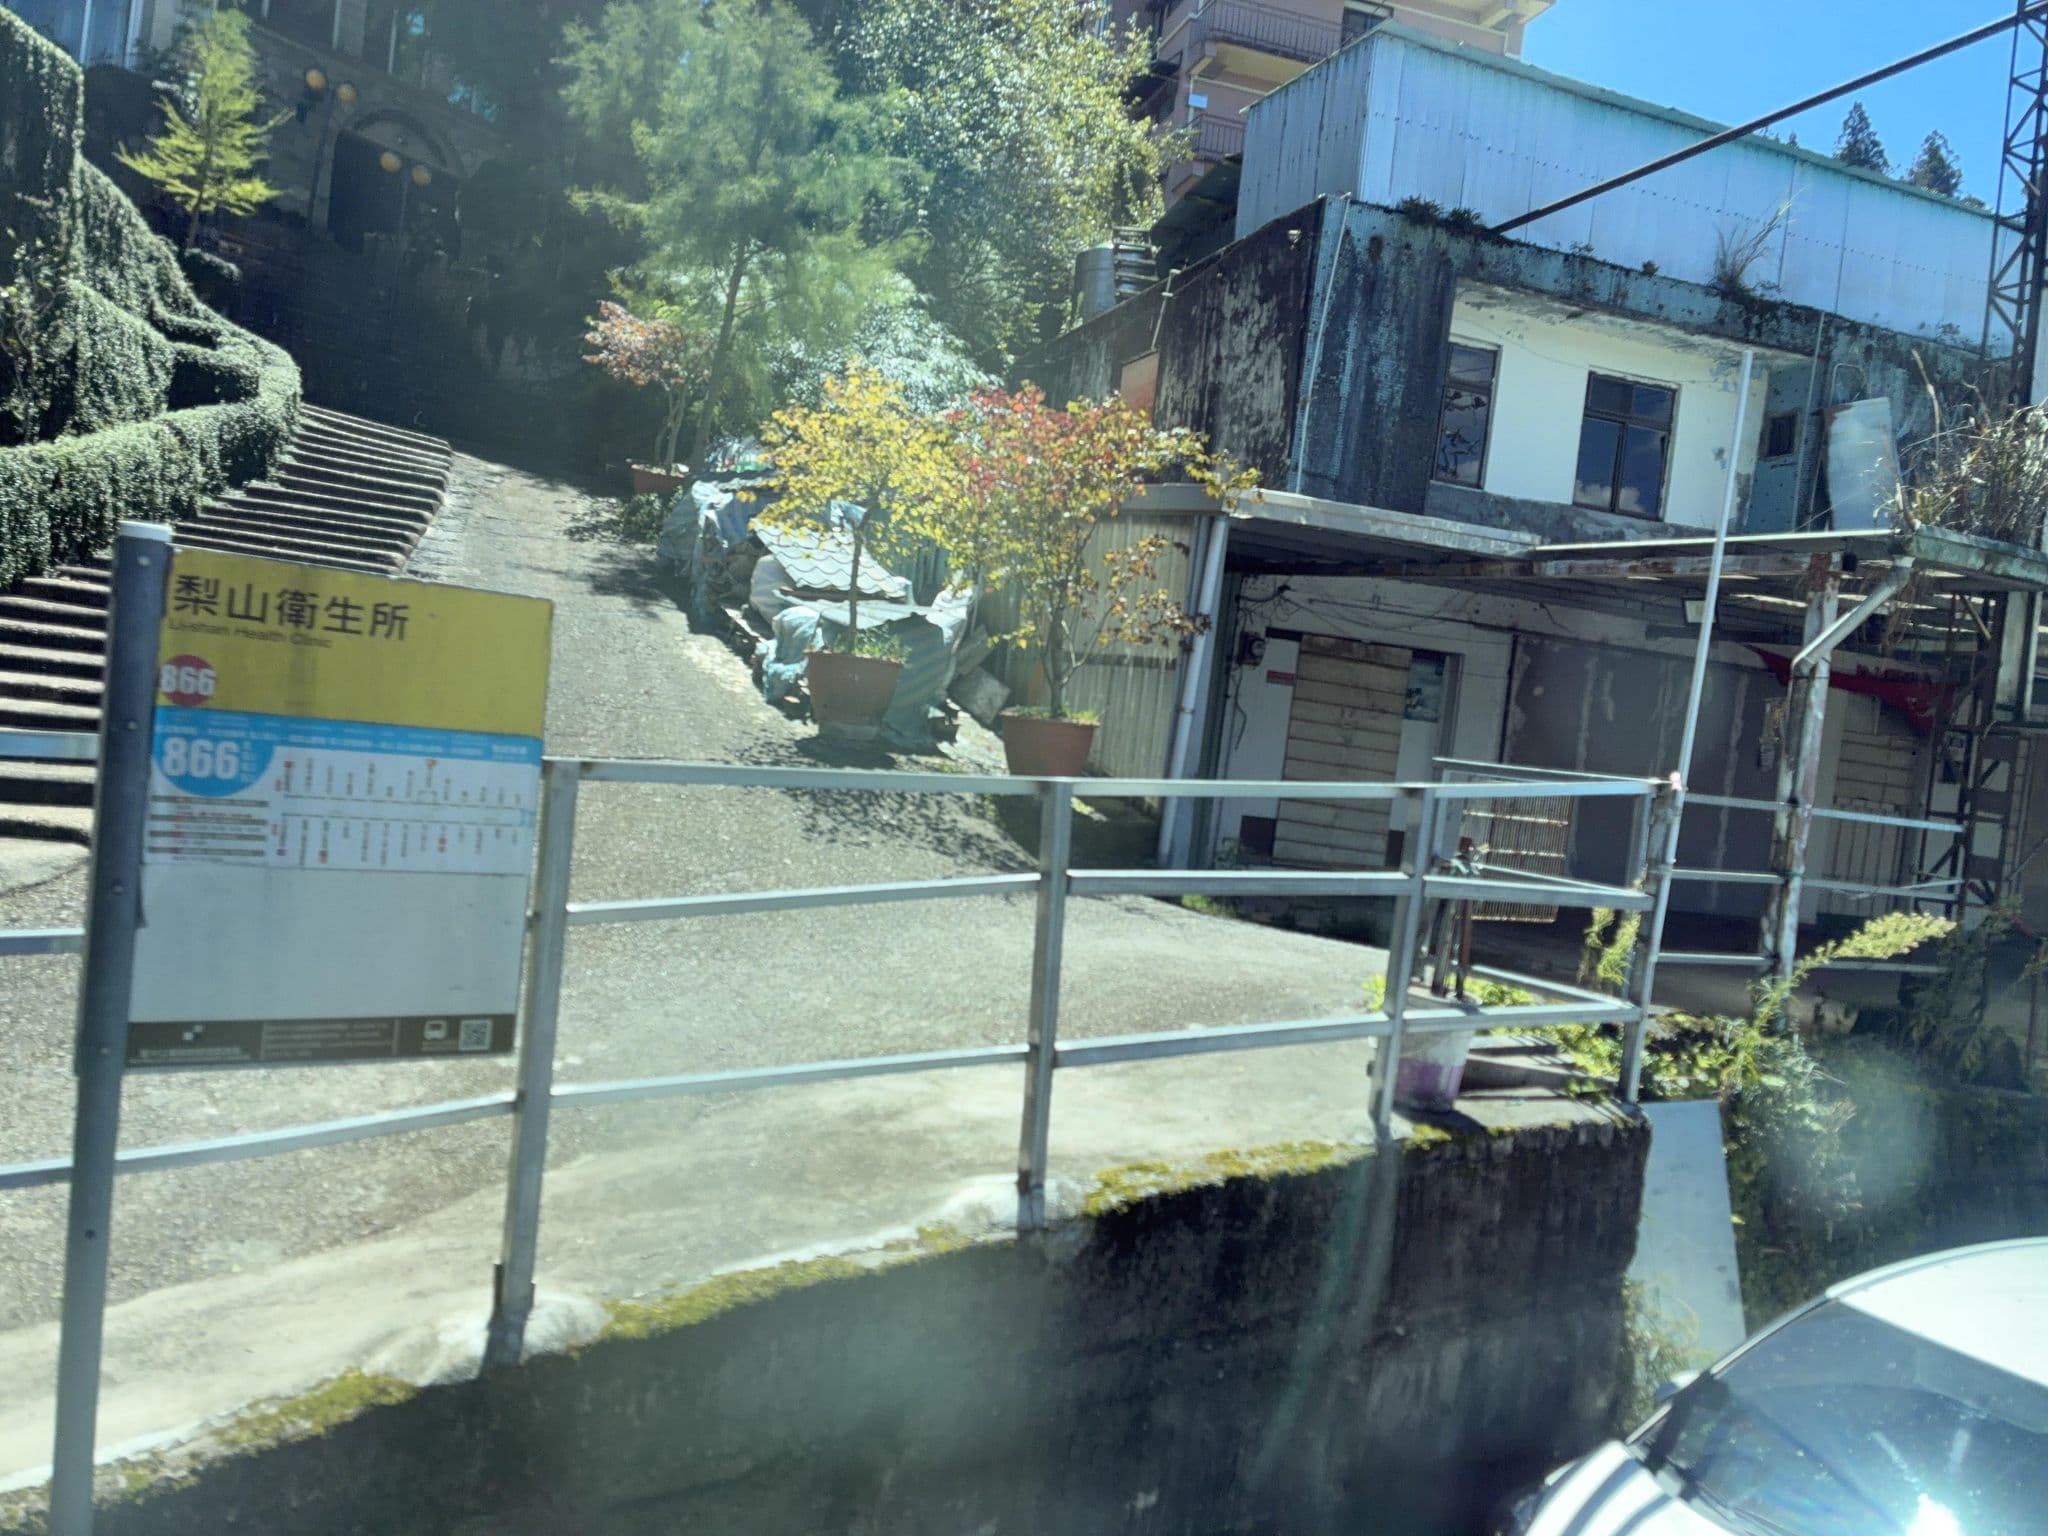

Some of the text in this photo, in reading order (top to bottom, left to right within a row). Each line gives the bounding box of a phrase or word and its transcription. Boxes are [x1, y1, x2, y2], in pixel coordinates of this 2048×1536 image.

[173, 574, 410, 641] 梨山衛生所
[160, 664, 217, 696] 866
[162, 736, 241, 780] 866
